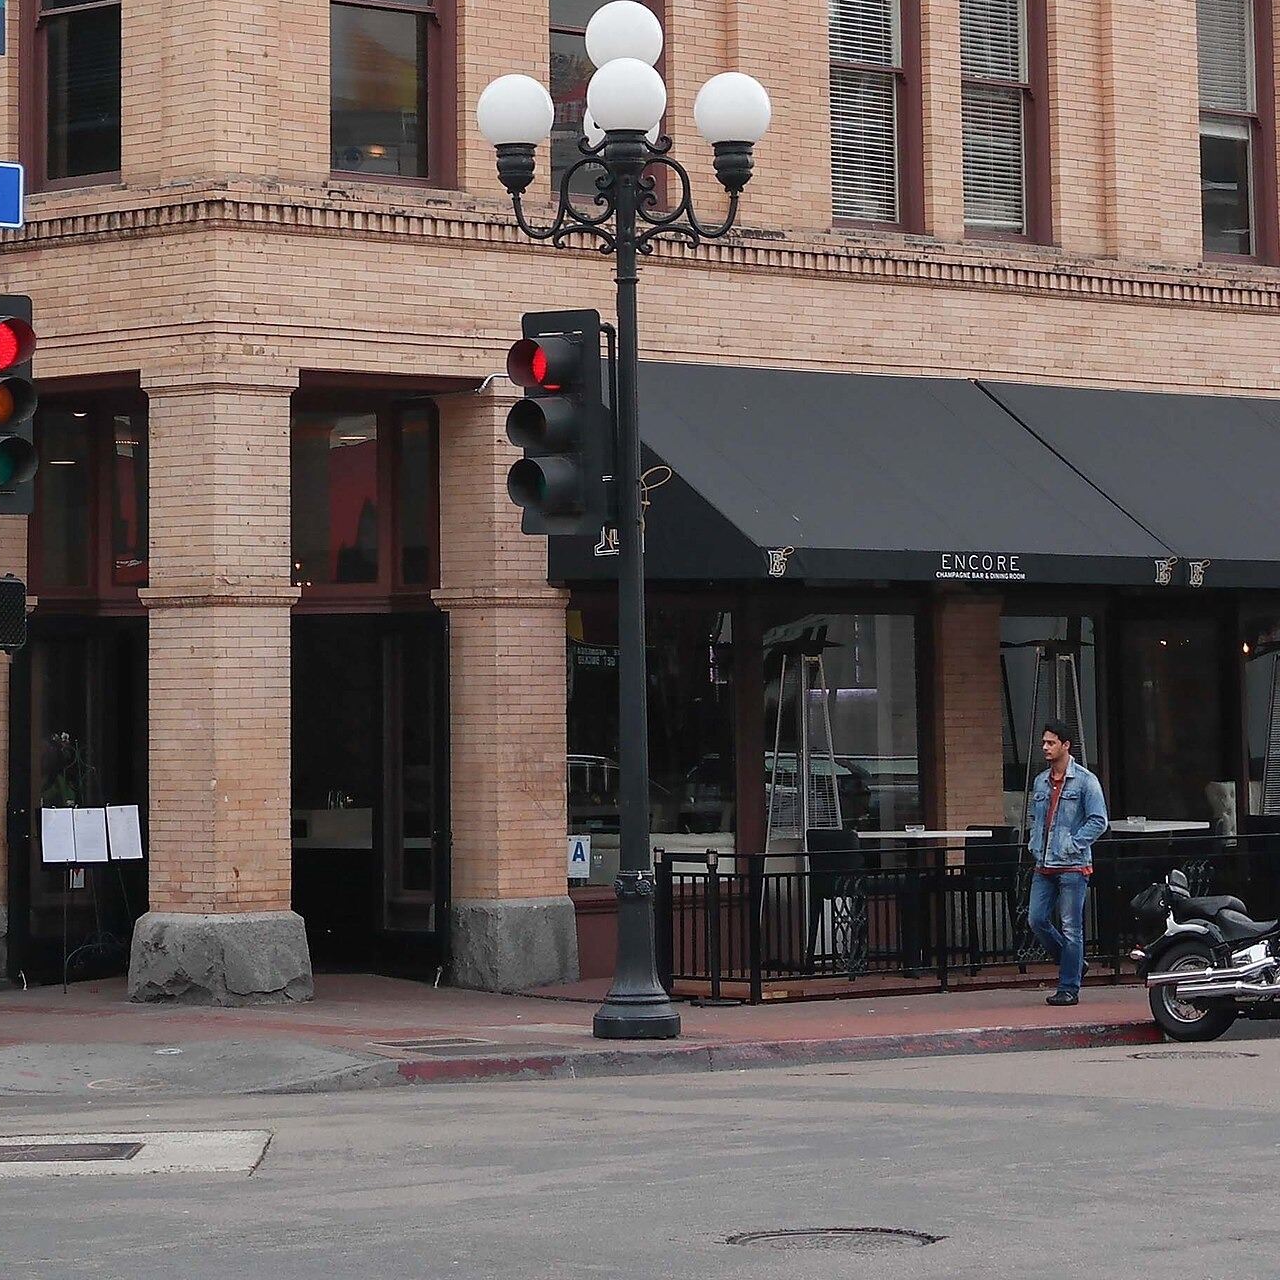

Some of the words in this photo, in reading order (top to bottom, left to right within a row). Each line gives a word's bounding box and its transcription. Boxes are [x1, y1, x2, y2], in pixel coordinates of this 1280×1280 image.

[941, 553, 1020, 572] ENCORE
[935, 571, 971, 580] CHAMPAGNE
[971, 572, 984, 580] BAR
[990, 572, 1009, 580] DINING
[1009, 572, 1026, 580] ROOM
[572, 841, 586, 862] A
